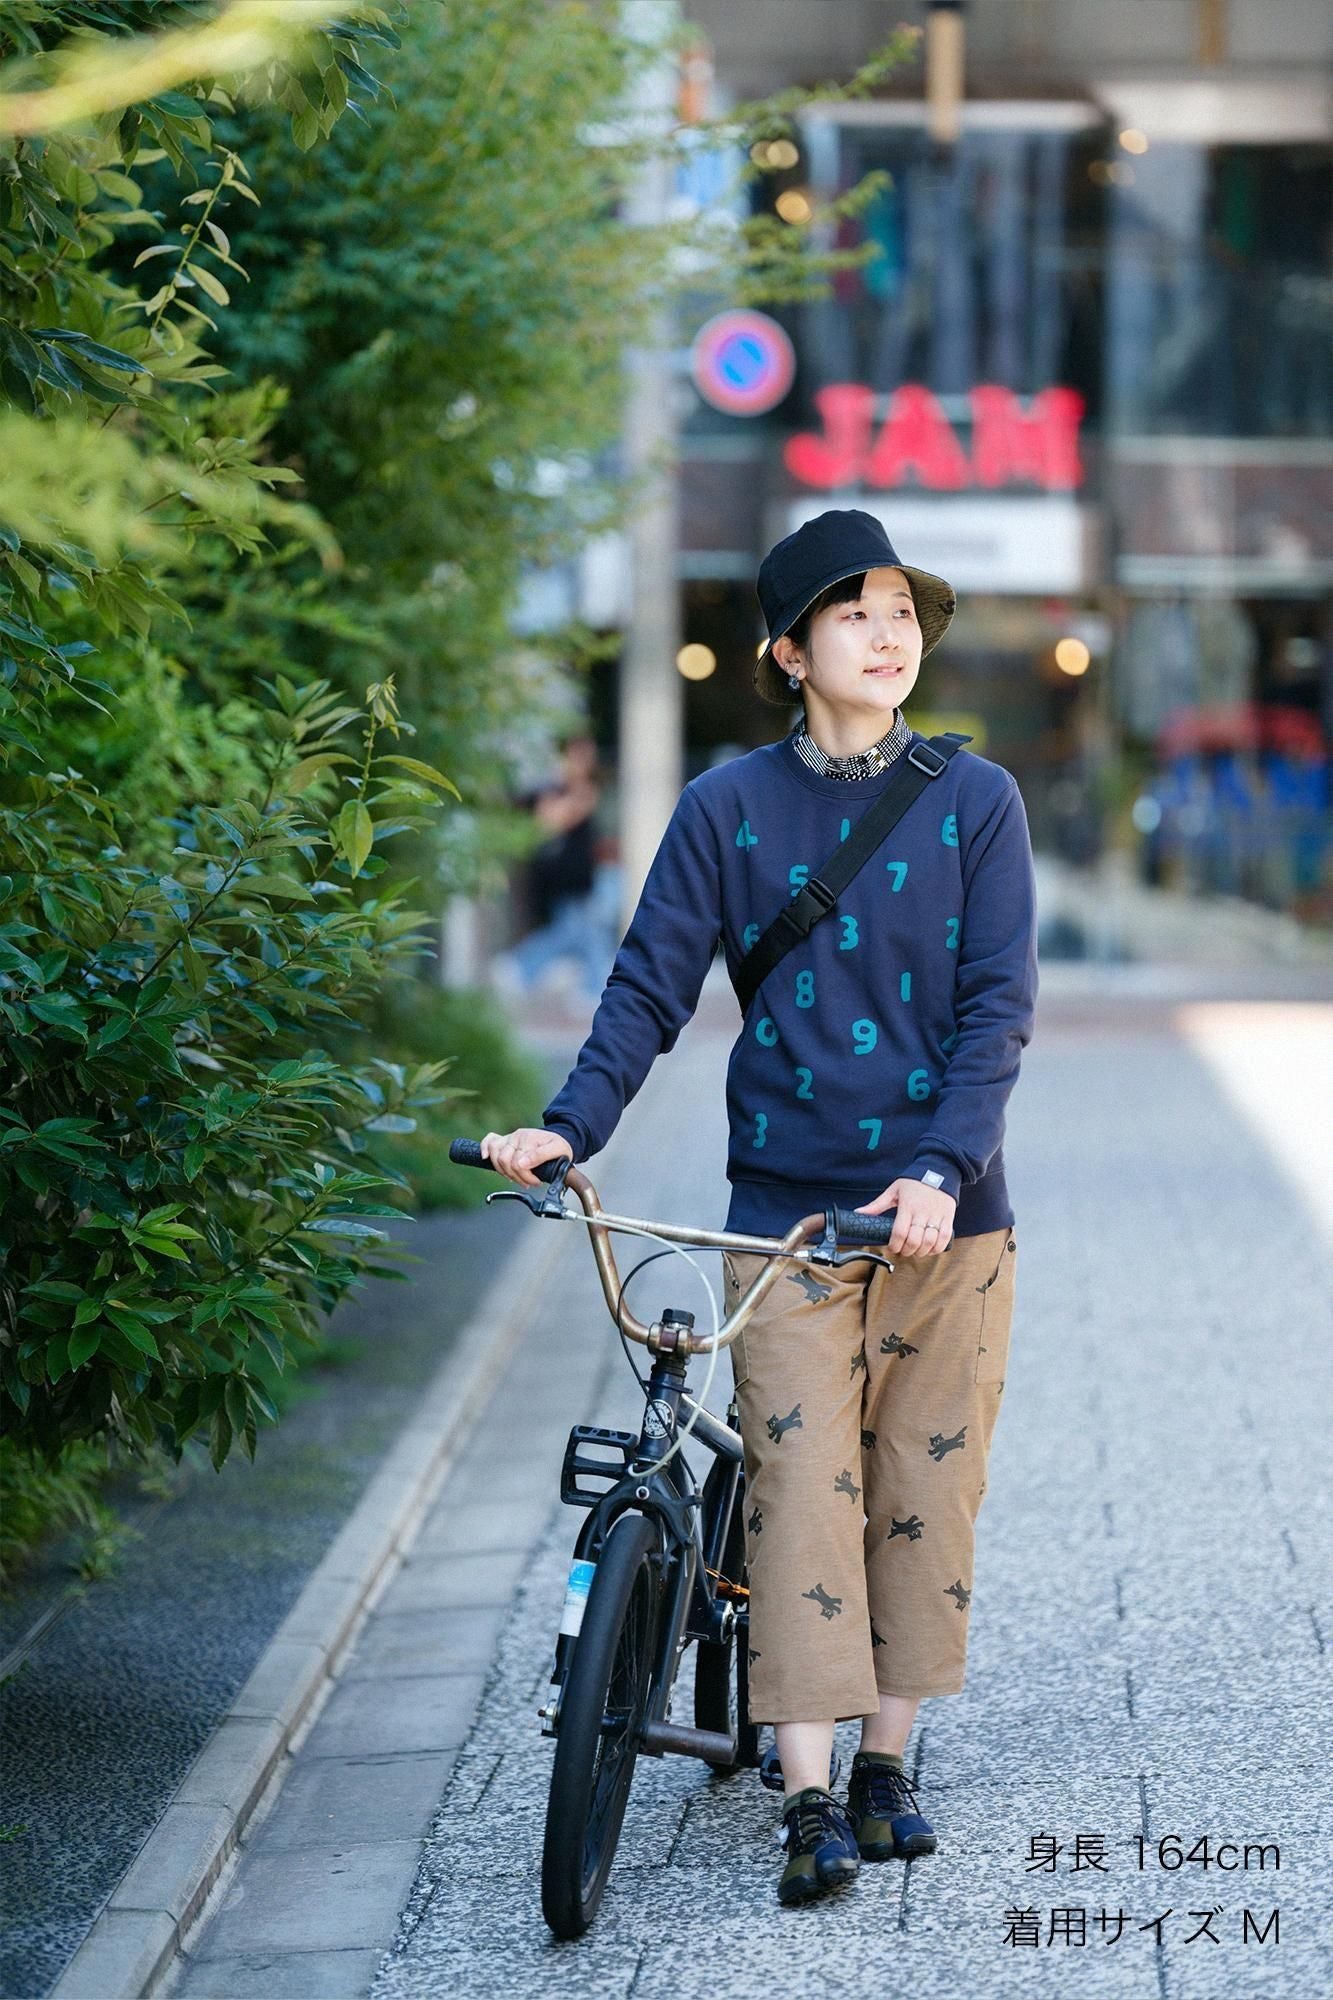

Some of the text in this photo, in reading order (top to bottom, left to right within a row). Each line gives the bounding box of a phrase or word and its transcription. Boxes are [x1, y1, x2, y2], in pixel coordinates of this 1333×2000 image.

[783, 383, 1085, 490] JAM
[735, 820, 759, 852] 4
[788, 861, 909, 897] 5 7
[839, 915, 860, 951] 3
[795, 969, 912, 1009] 8 1
[755, 1017, 878, 1056] 0 9
[796, 1067, 932, 1100] 2 6
[753, 1113, 883, 1150] 3 7
